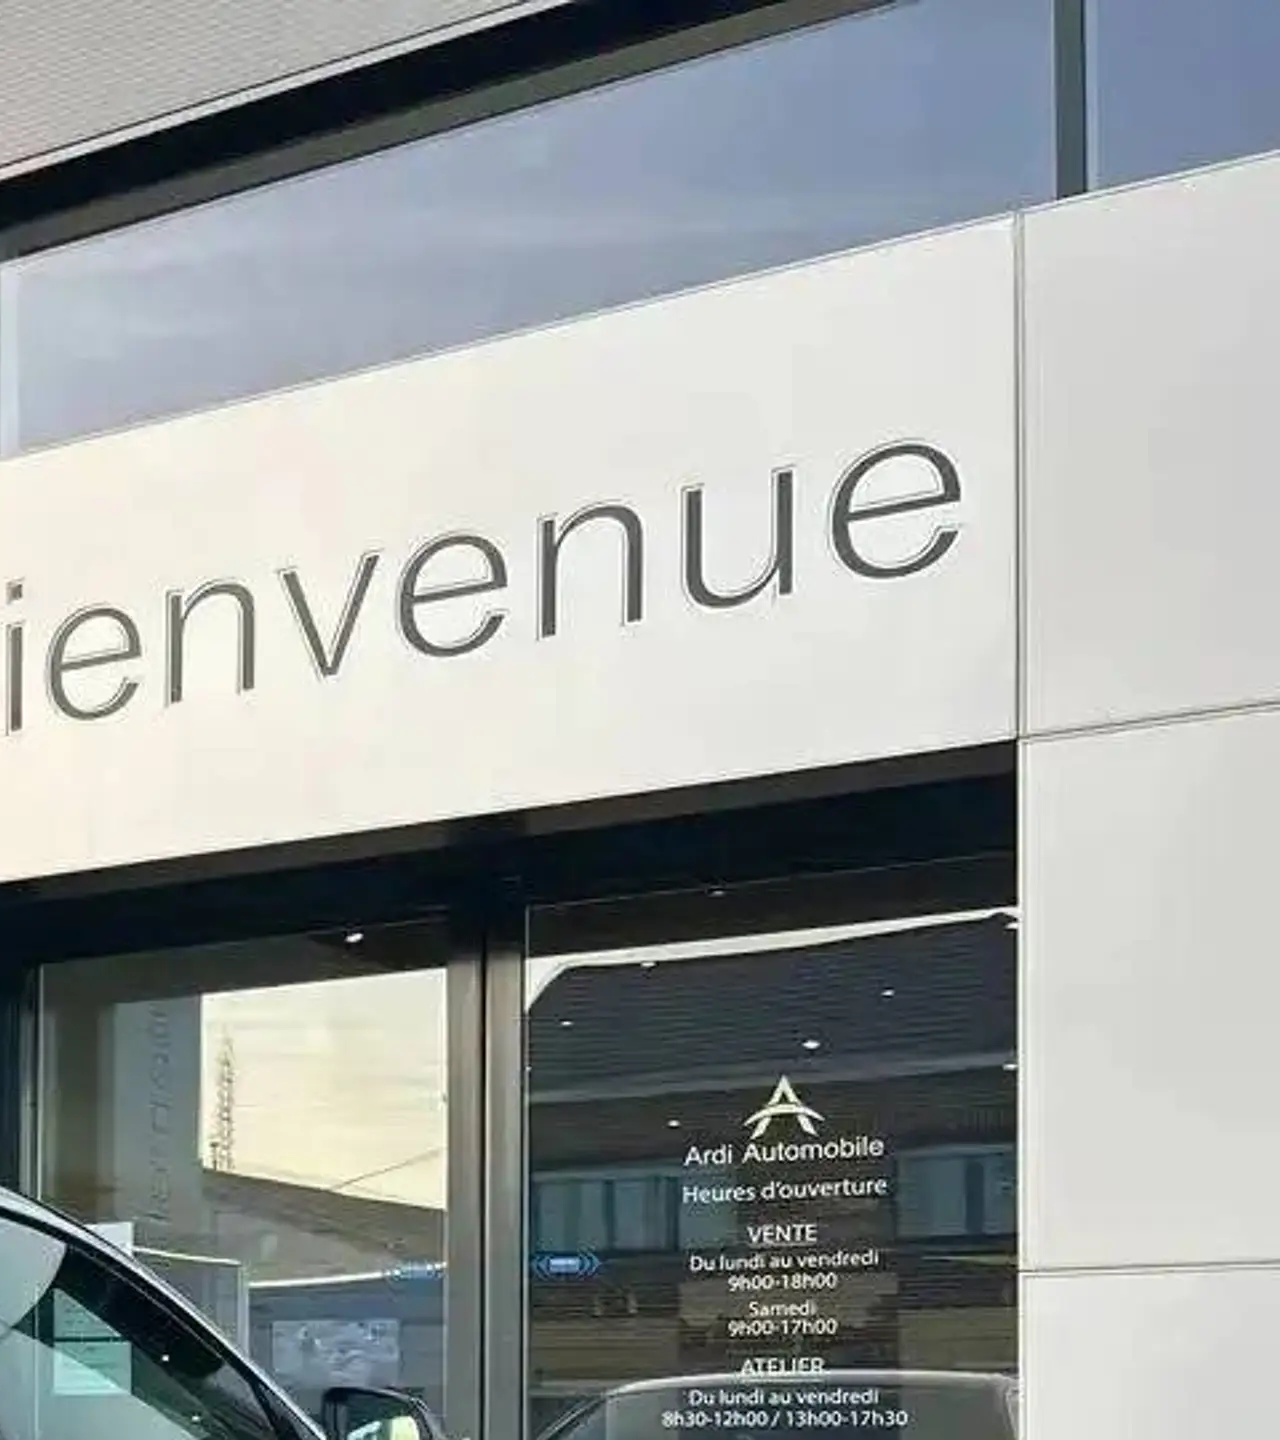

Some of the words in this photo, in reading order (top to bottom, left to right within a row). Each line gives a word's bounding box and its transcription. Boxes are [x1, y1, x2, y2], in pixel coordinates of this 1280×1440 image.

[683, 1143, 733, 1166] Ardi
[741, 1136, 885, 1163] Automobile
[681, 1185, 756, 1205] Heures
[759, 1178, 889, 1201] d'ouverture
[746, 1223, 818, 1243] VENTE
[689, 1256, 715, 1272] Du
[719, 1254, 766, 1270] lundi
[769, 1256, 792, 1269] au
[795, 1249, 880, 1268] vendredi
[726, 1272, 838, 1292] 9h00-18h00
[748, 1300, 818, 1318] Samedi
[726, 1318, 838, 1338] 9h00-17h00
[740, 1356, 827, 1377] ATELIER
[688, 1390, 715, 1405] Du
[719, 1389, 765, 1405] lundi
[768, 1392, 791, 1405] au
[795, 1388, 880, 1405] vendredi
